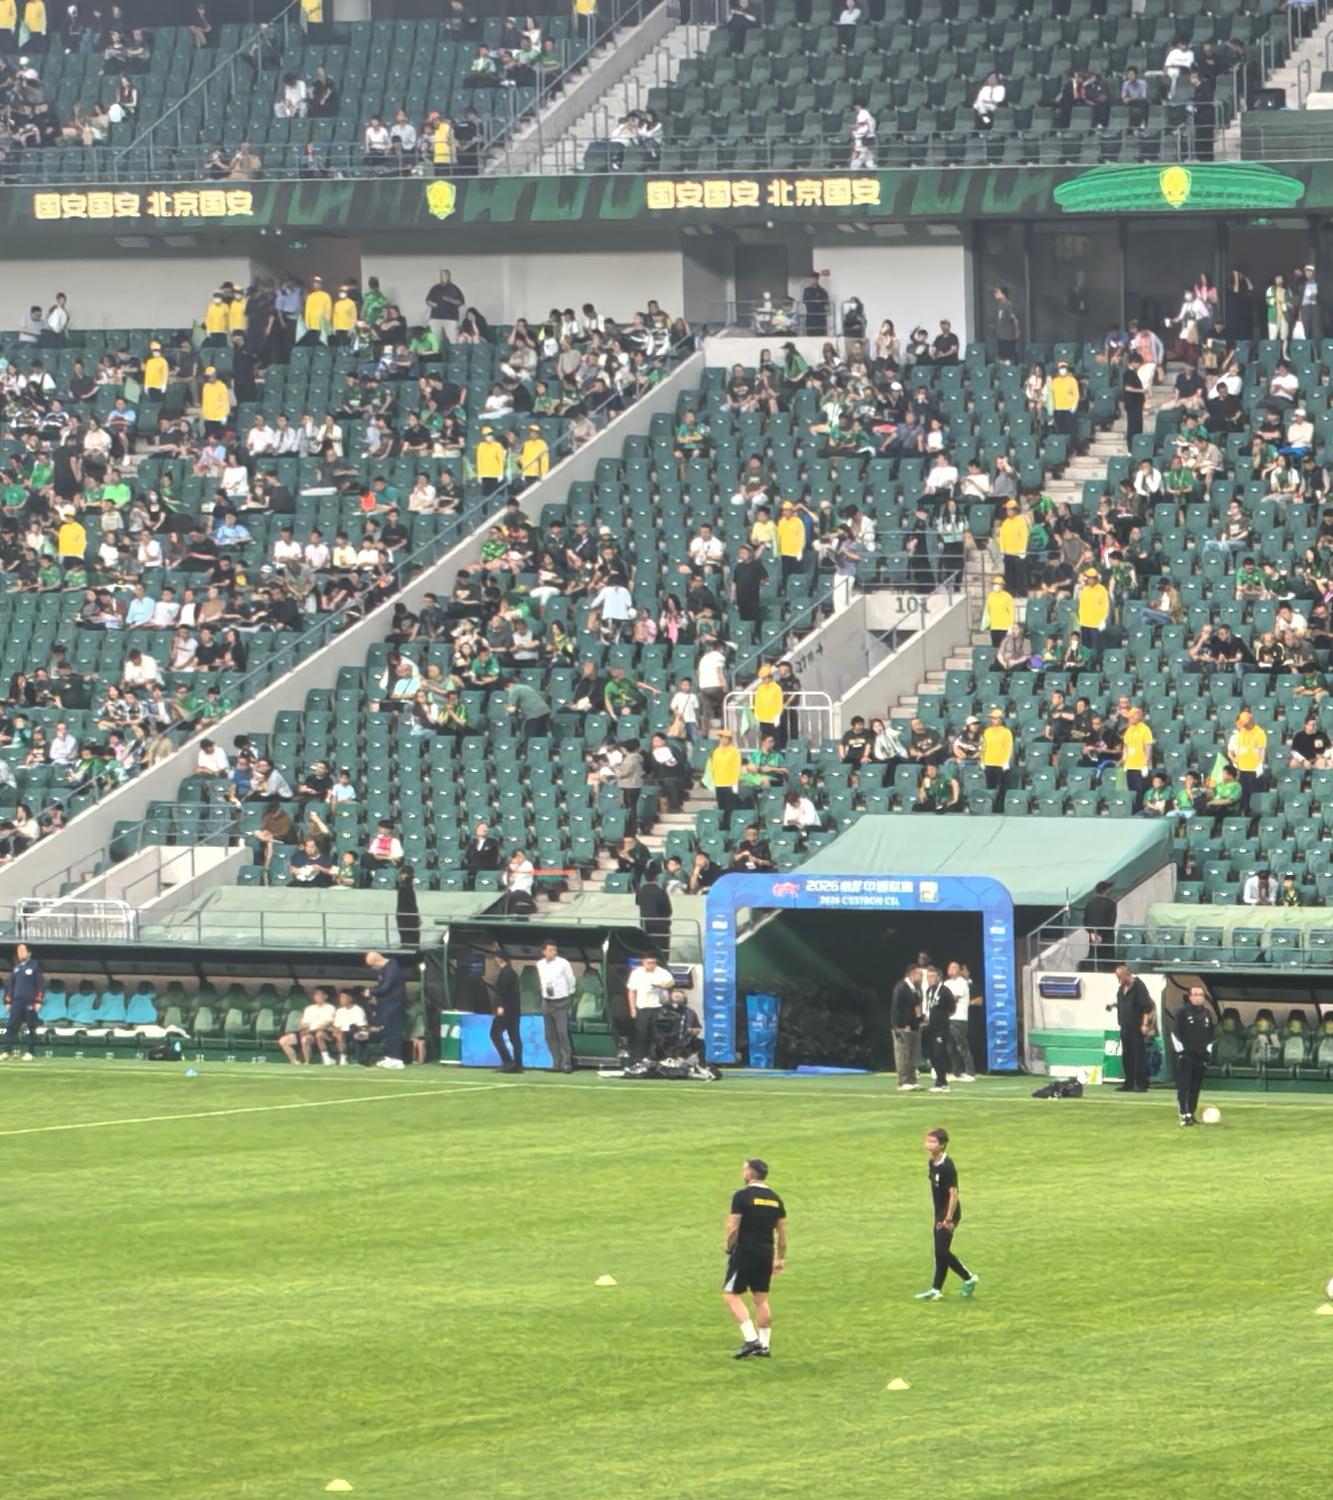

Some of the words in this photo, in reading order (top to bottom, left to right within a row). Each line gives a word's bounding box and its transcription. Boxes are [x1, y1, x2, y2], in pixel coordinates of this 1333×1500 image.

[34, 191, 141, 219] 国安国安
[147, 190, 254, 217] 北京国安
[647, 179, 760, 209] 国安国安
[766, 177, 881, 207] 北京国安
[895, 596, 931, 613] 101
